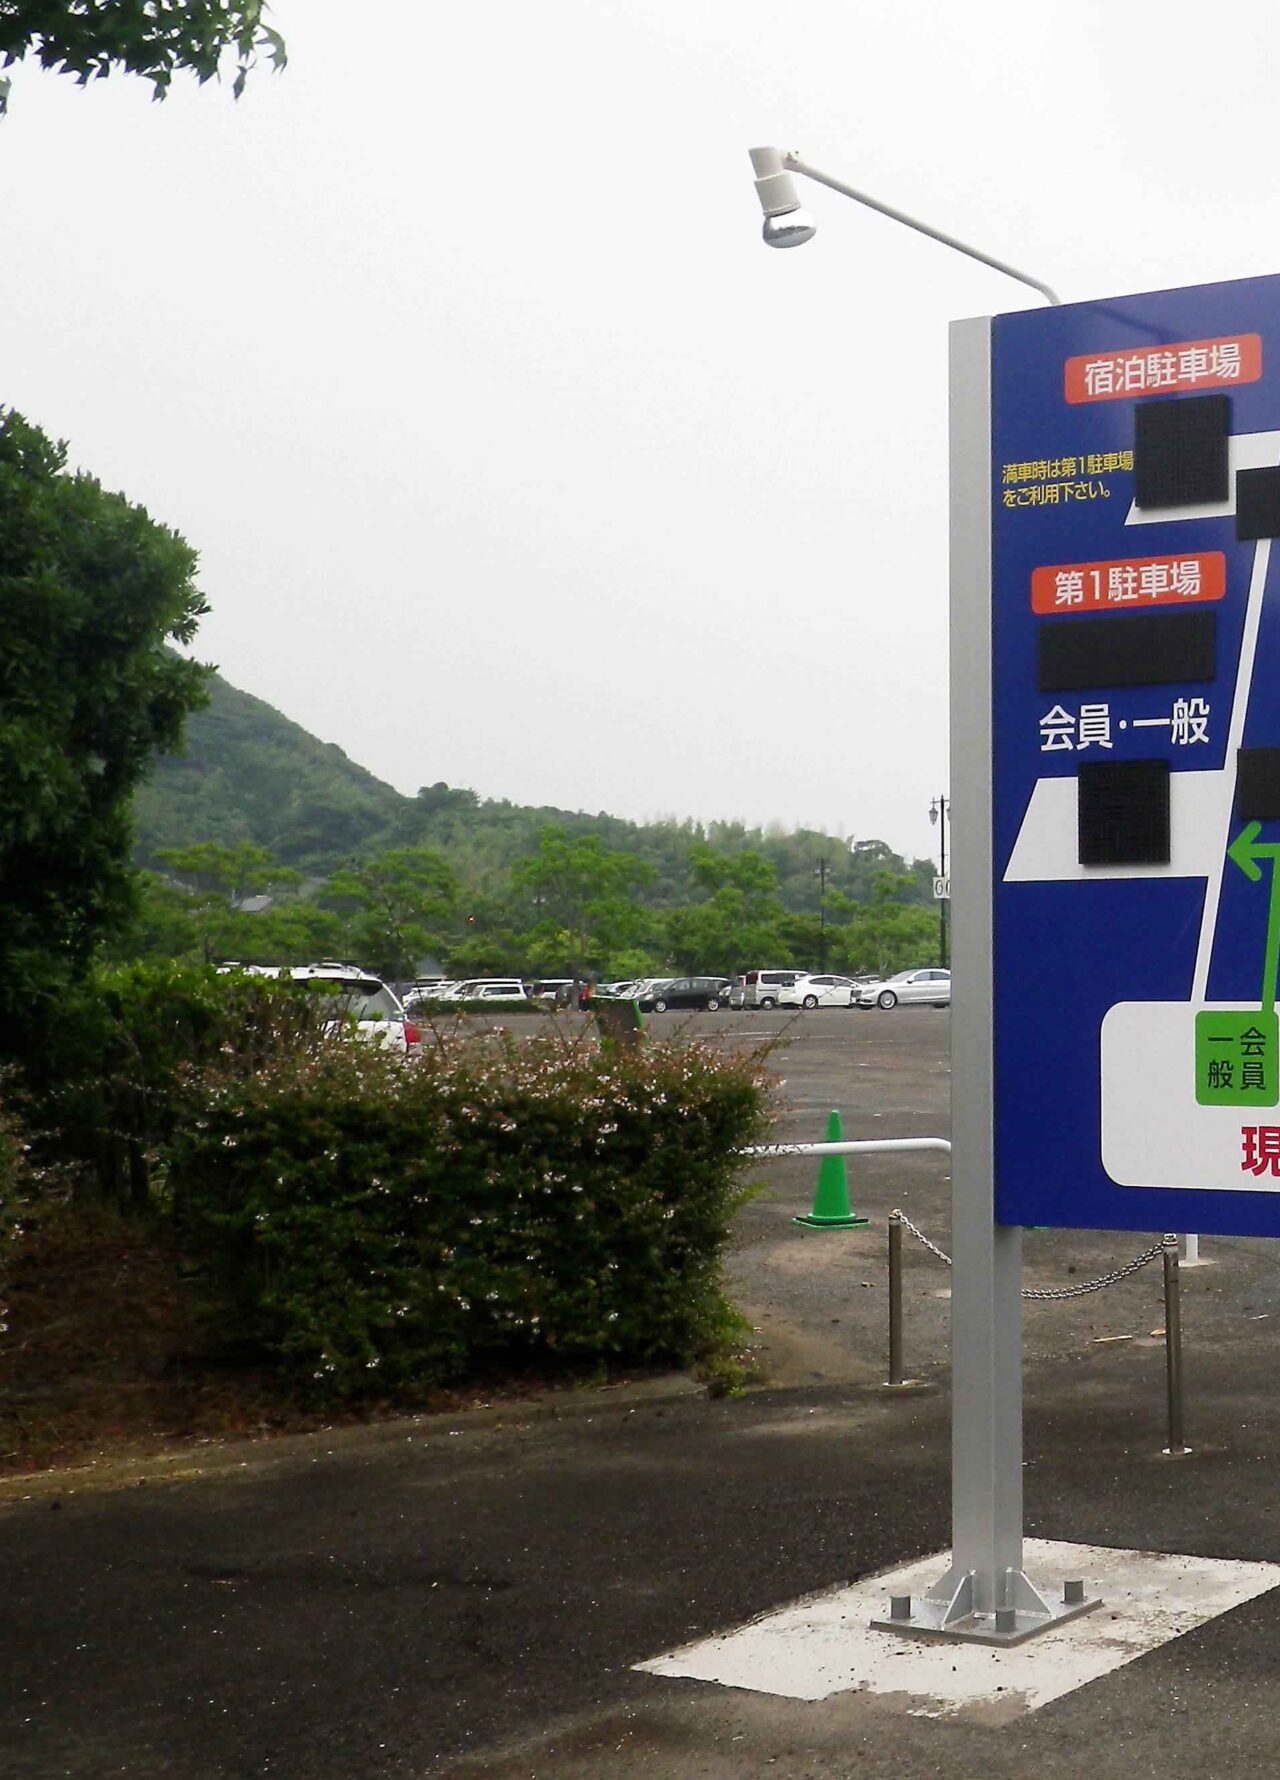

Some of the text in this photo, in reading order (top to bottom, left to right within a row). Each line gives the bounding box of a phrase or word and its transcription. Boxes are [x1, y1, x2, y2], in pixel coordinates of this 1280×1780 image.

[1084, 343, 1241, 396] 宿泊駐車場
[1002, 450, 1134, 484] 満車時は第1駐車場
[1002, 480, 1111, 507] をご利用下さい。
[1054, 560, 1201, 606] 第1駐車場
[1207, 1036, 1234, 1089] 一般
[1239, 1026, 1266, 1091] 会員
